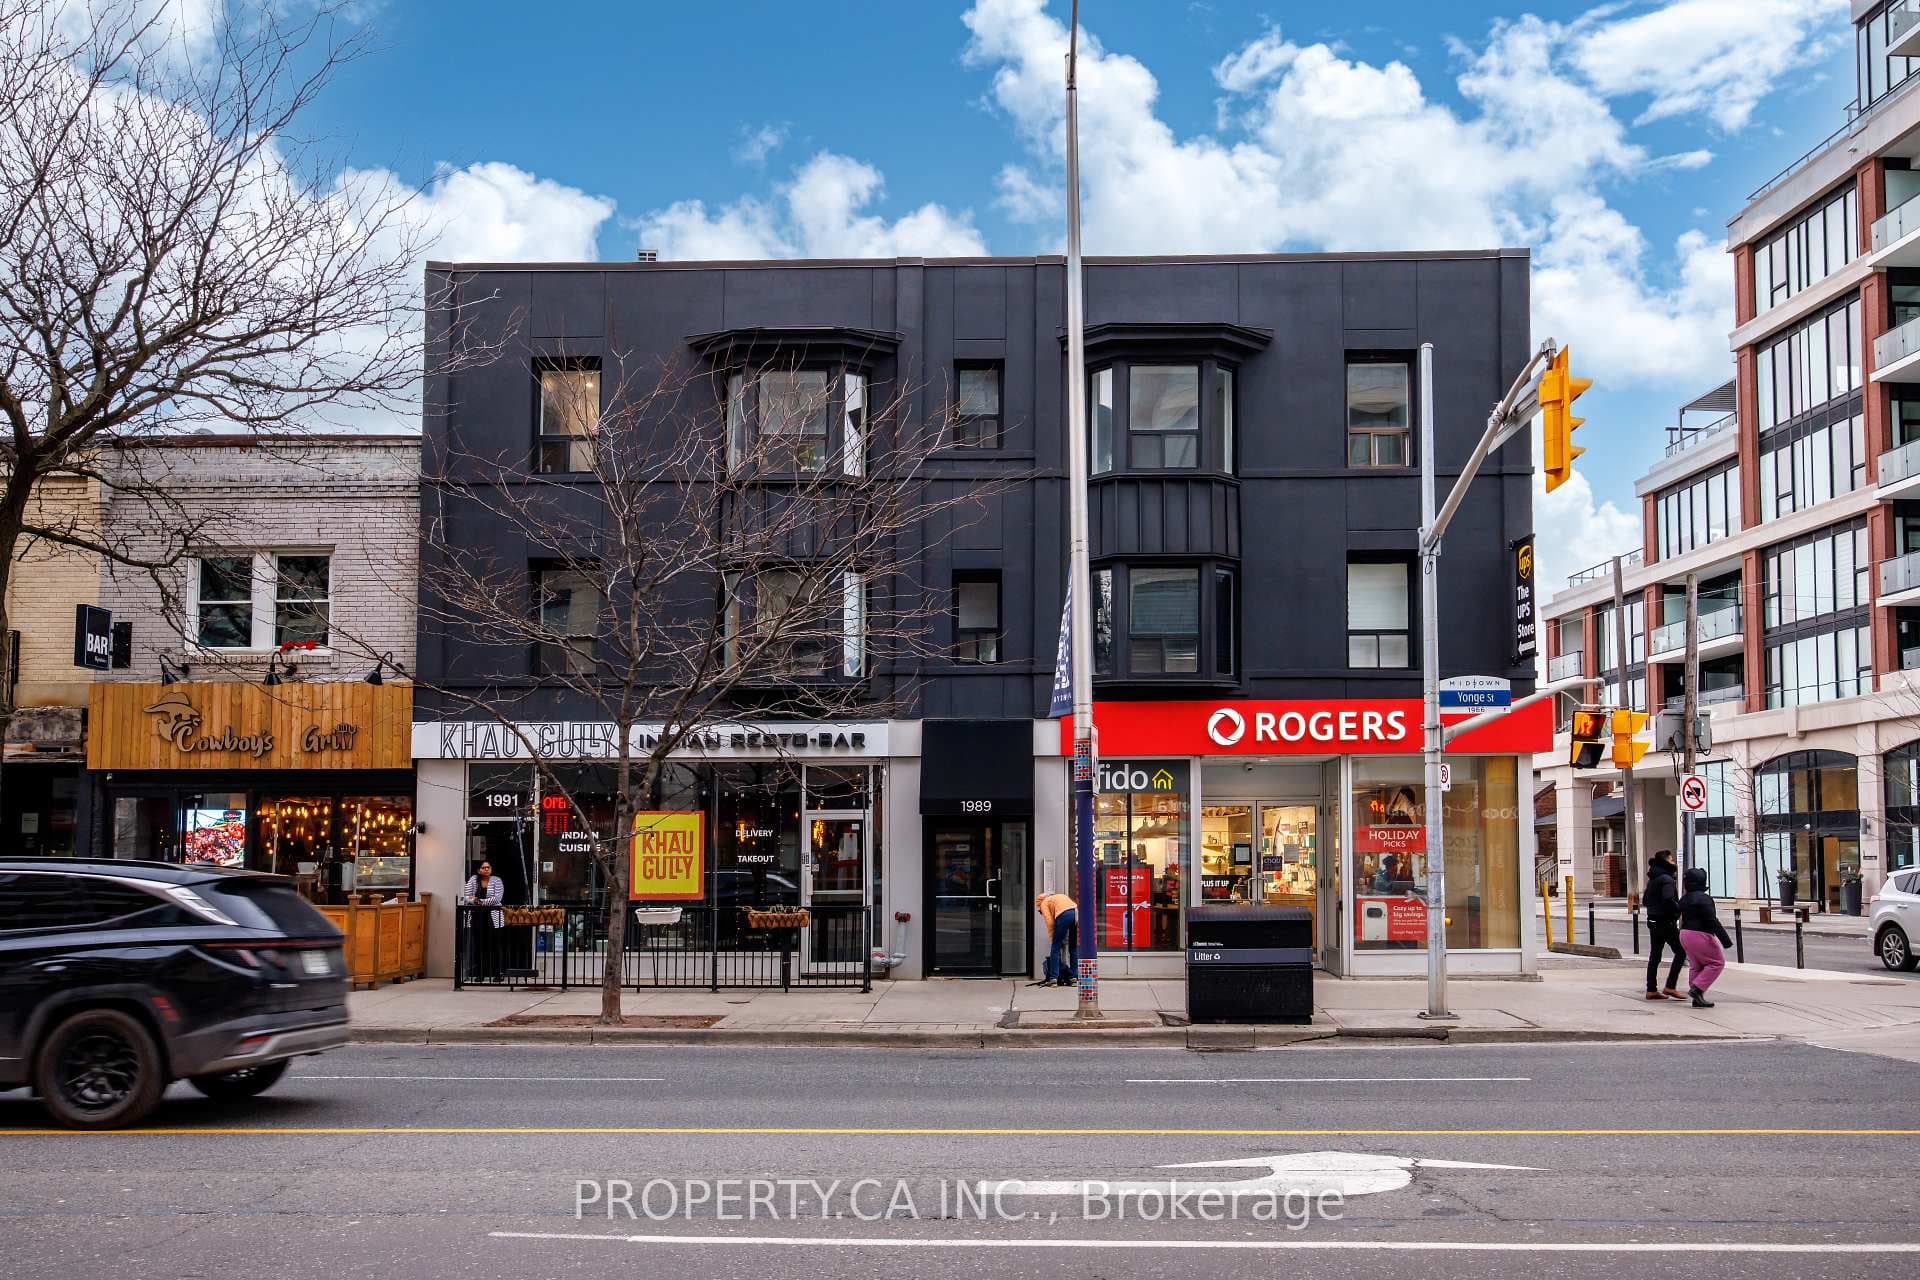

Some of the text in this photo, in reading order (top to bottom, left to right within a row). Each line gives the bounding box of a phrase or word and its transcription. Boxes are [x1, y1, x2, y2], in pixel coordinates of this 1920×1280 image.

[1520, 554, 1530, 574] ups
[1517, 586, 1529, 601] The
[1517, 602, 1531, 619] UPS
[1517, 622, 1535, 639] Store
[86, 632, 109, 656] BAR
[1457, 691, 1495, 705] Yonge St
[1255, 711, 1406, 742] ROGERS
[176, 725, 274, 758] Cowboy's
[441, 721, 617, 758] KHAU GULLY
[639, 733, 721, 749] INIAN
[486, 794, 519, 807] 1991
[543, 796, 572, 809] OPE
[960, 800, 992, 812] 1989
[735, 829, 774, 838] DELIVERY
[1369, 830, 1420, 841] HOLIDAY
[642, 830, 694, 855] KHAU
[1383, 840, 1407, 848] PICKS
[737, 855, 775, 864] TAKEOUT
[642, 855, 694, 880] GULLY
[1199, 880, 1230, 888] PLUS IT UP
[1194, 951, 1213, 961] Litter
